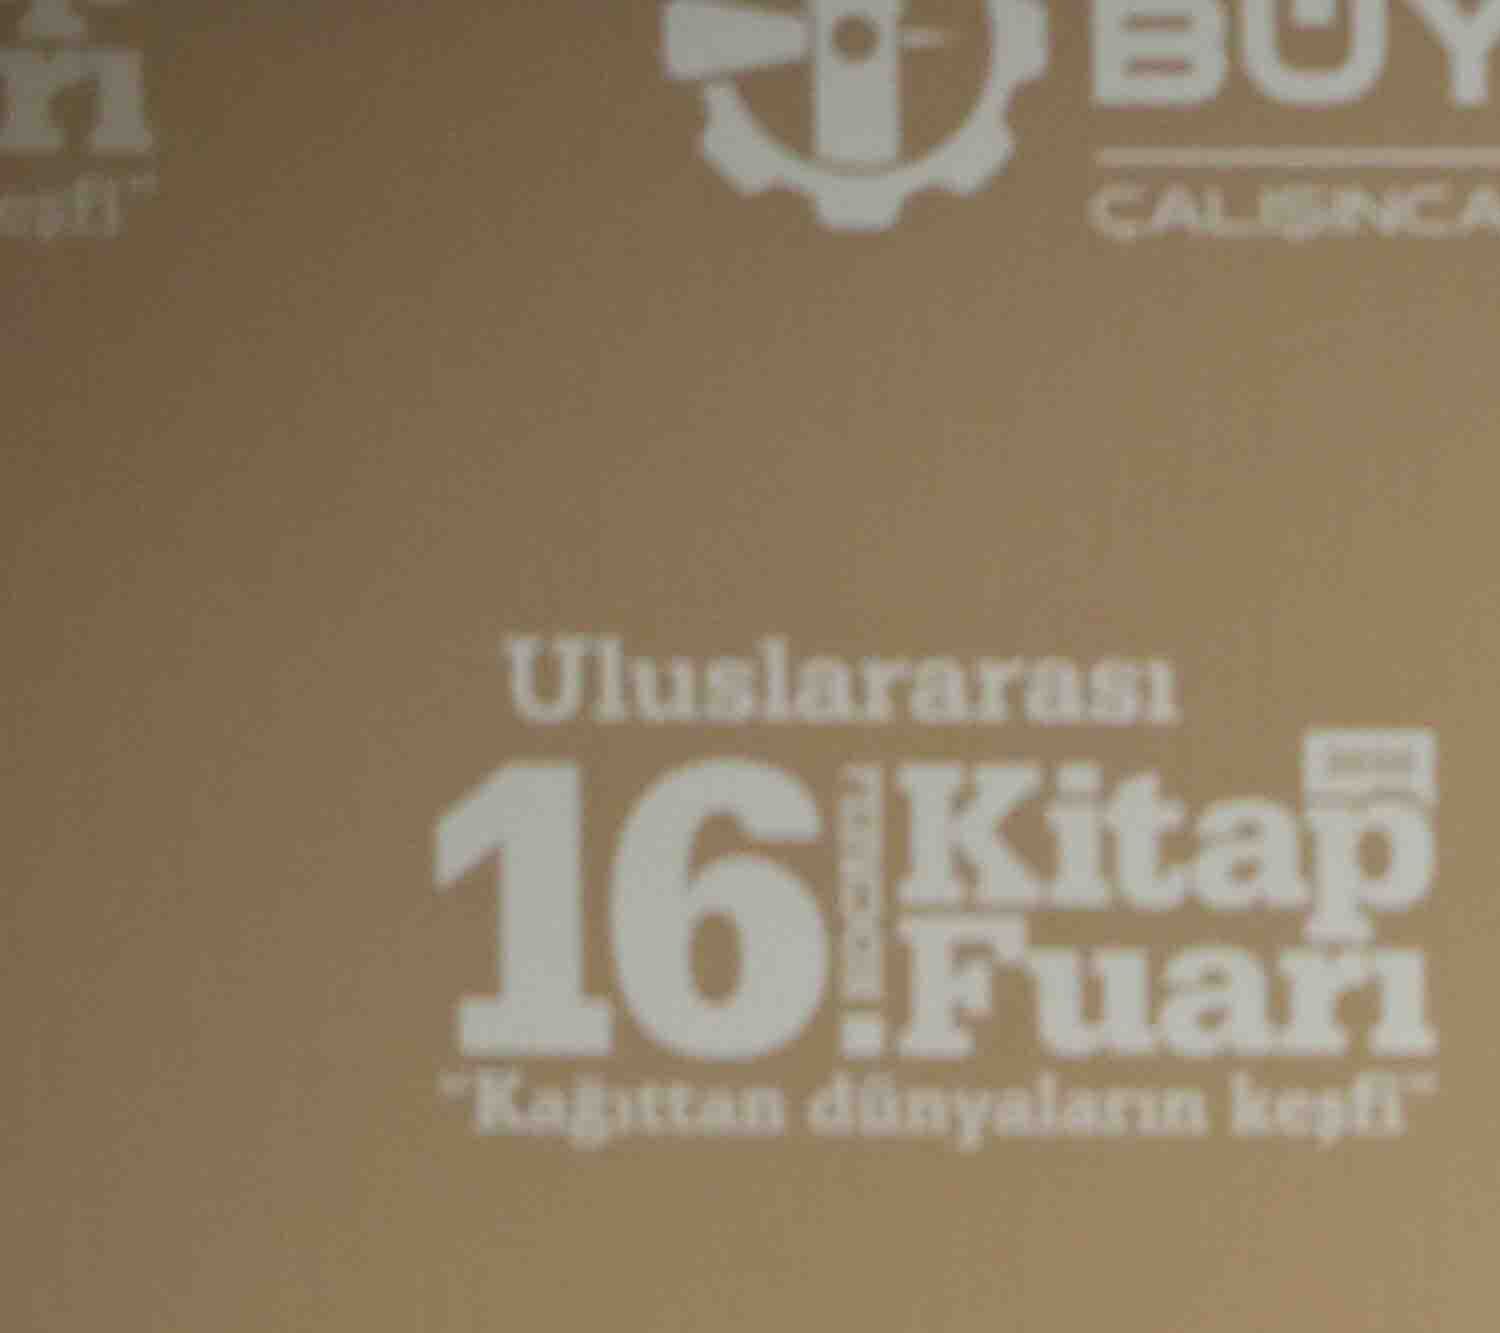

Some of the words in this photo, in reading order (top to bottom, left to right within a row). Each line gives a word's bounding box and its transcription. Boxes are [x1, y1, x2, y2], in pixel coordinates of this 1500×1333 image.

[505, 635, 1182, 724] Uluslararası
[898, 763, 1437, 942] Kitap
[898, 915, 1437, 1059] Fuarı
